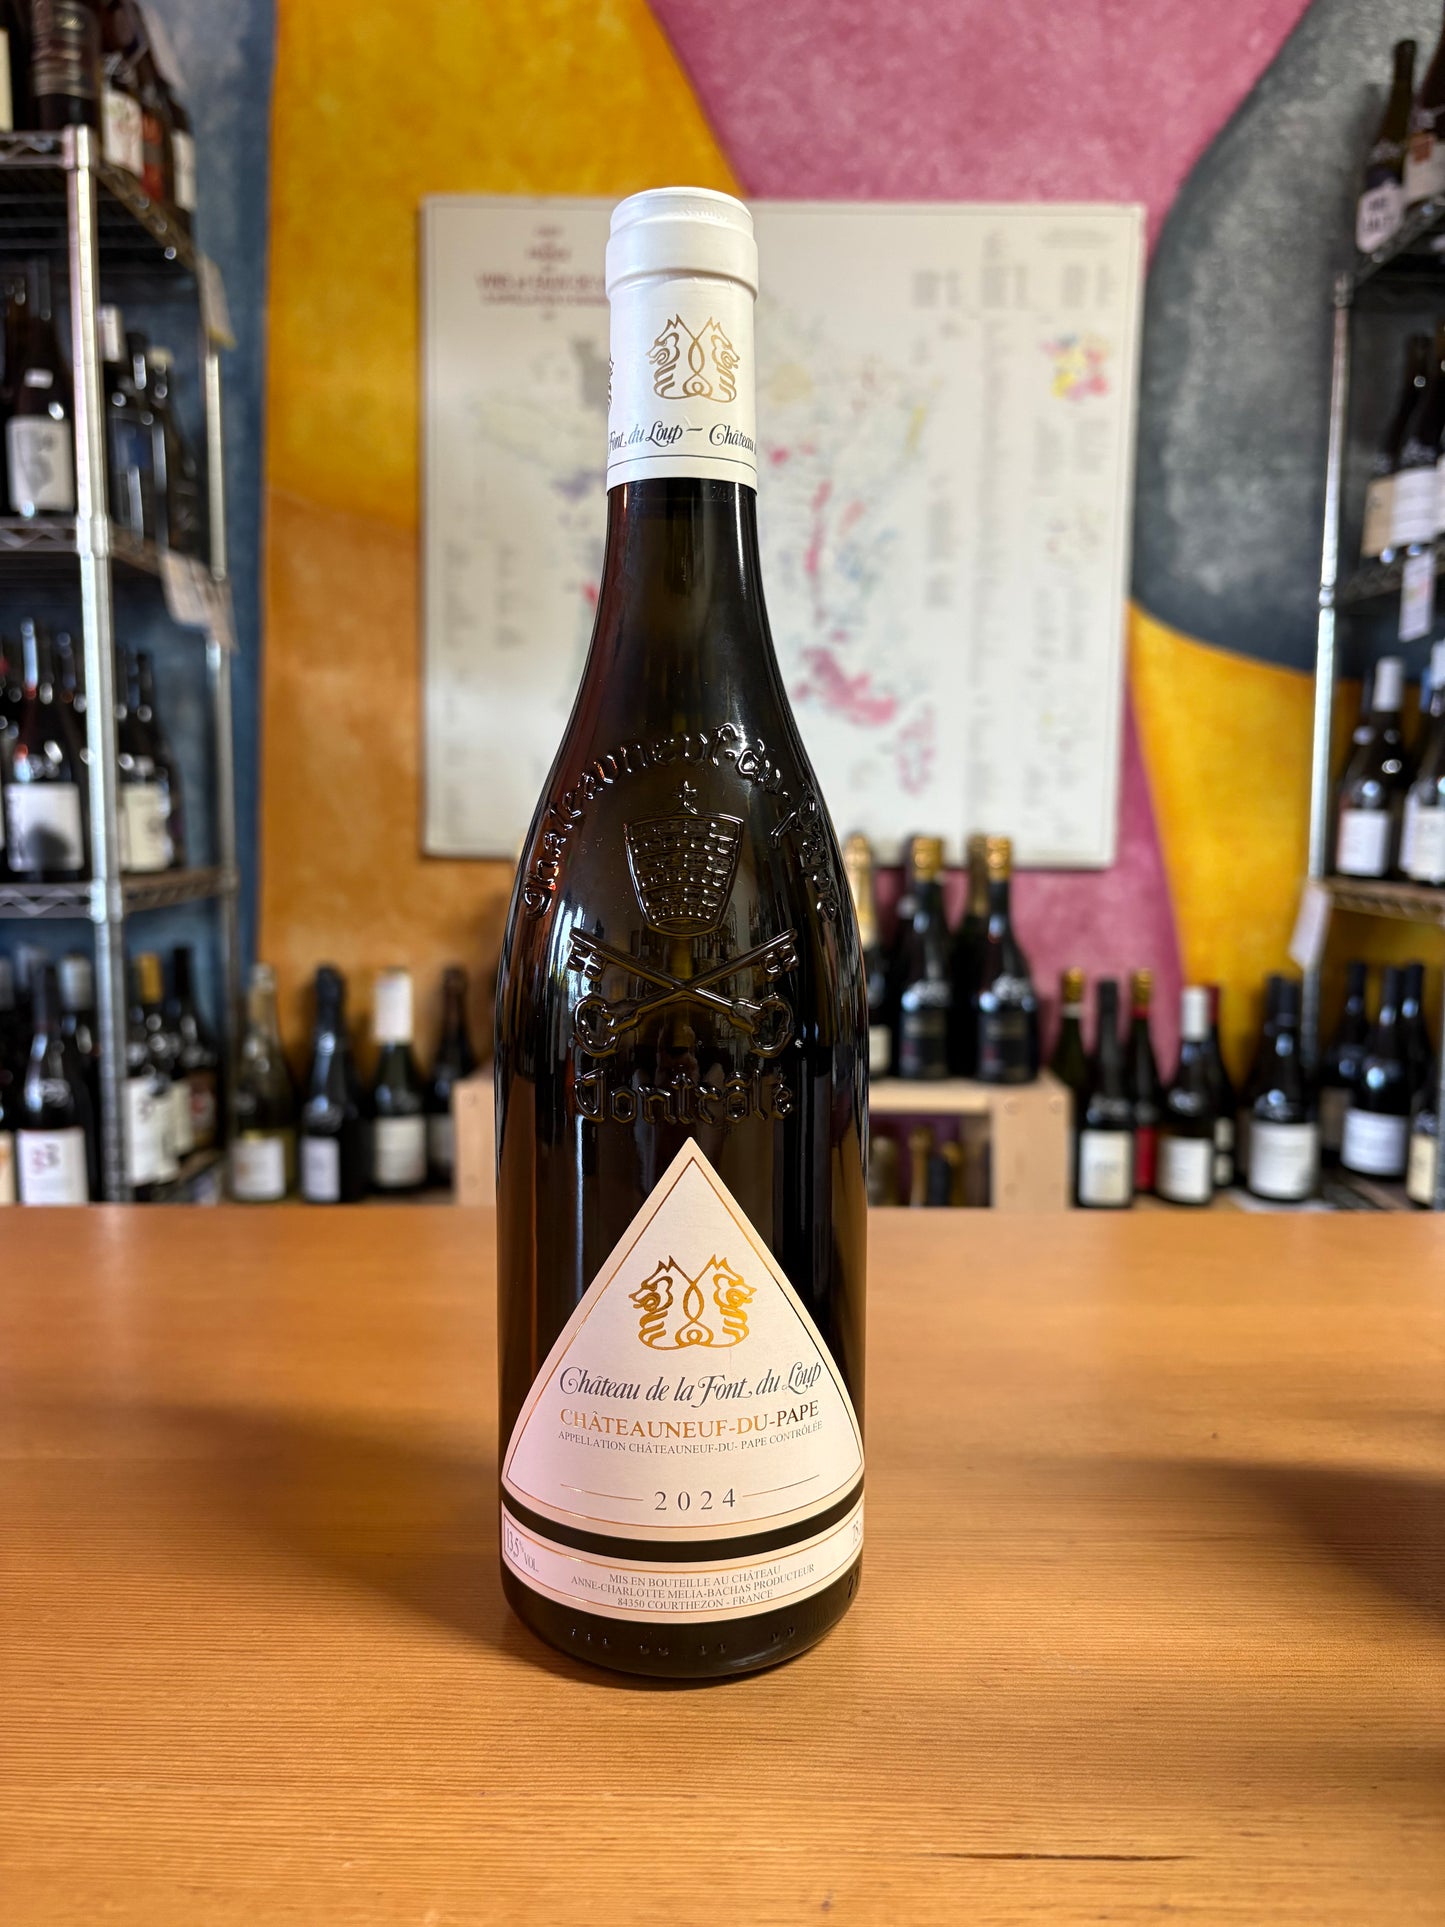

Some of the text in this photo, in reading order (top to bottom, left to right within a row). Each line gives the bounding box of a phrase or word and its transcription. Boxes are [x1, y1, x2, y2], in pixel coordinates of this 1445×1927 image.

[628, 424, 644, 444] du
[645, 420, 683, 447] Loup
[709, 423, 754, 451] Château
[560, 1361, 821, 1408] Château de la Font du Loup
[560, 1399, 820, 1439] CHÂTEAUNEUF-DU-PAPE
[558, 1430, 626, 1451] APPELLATION
[741, 1436, 767, 1449] PAPE
[769, 1420, 823, 1444] CONTRÔLÉE
[654, 1488, 736, 1512] 2024
[570, 1563, 815, 1600] ANNE-CHARLOTTE MELIA-BACHAS PRODUCTEUR
[609, 1565, 781, 1588] MIS EN BOUTEILLE AU CHÂTEAU
[617, 1597, 645, 1608] 84350
[647, 1599, 724, 1611] COURTHEZON
[732, 1589, 774, 1607] FRANCE
